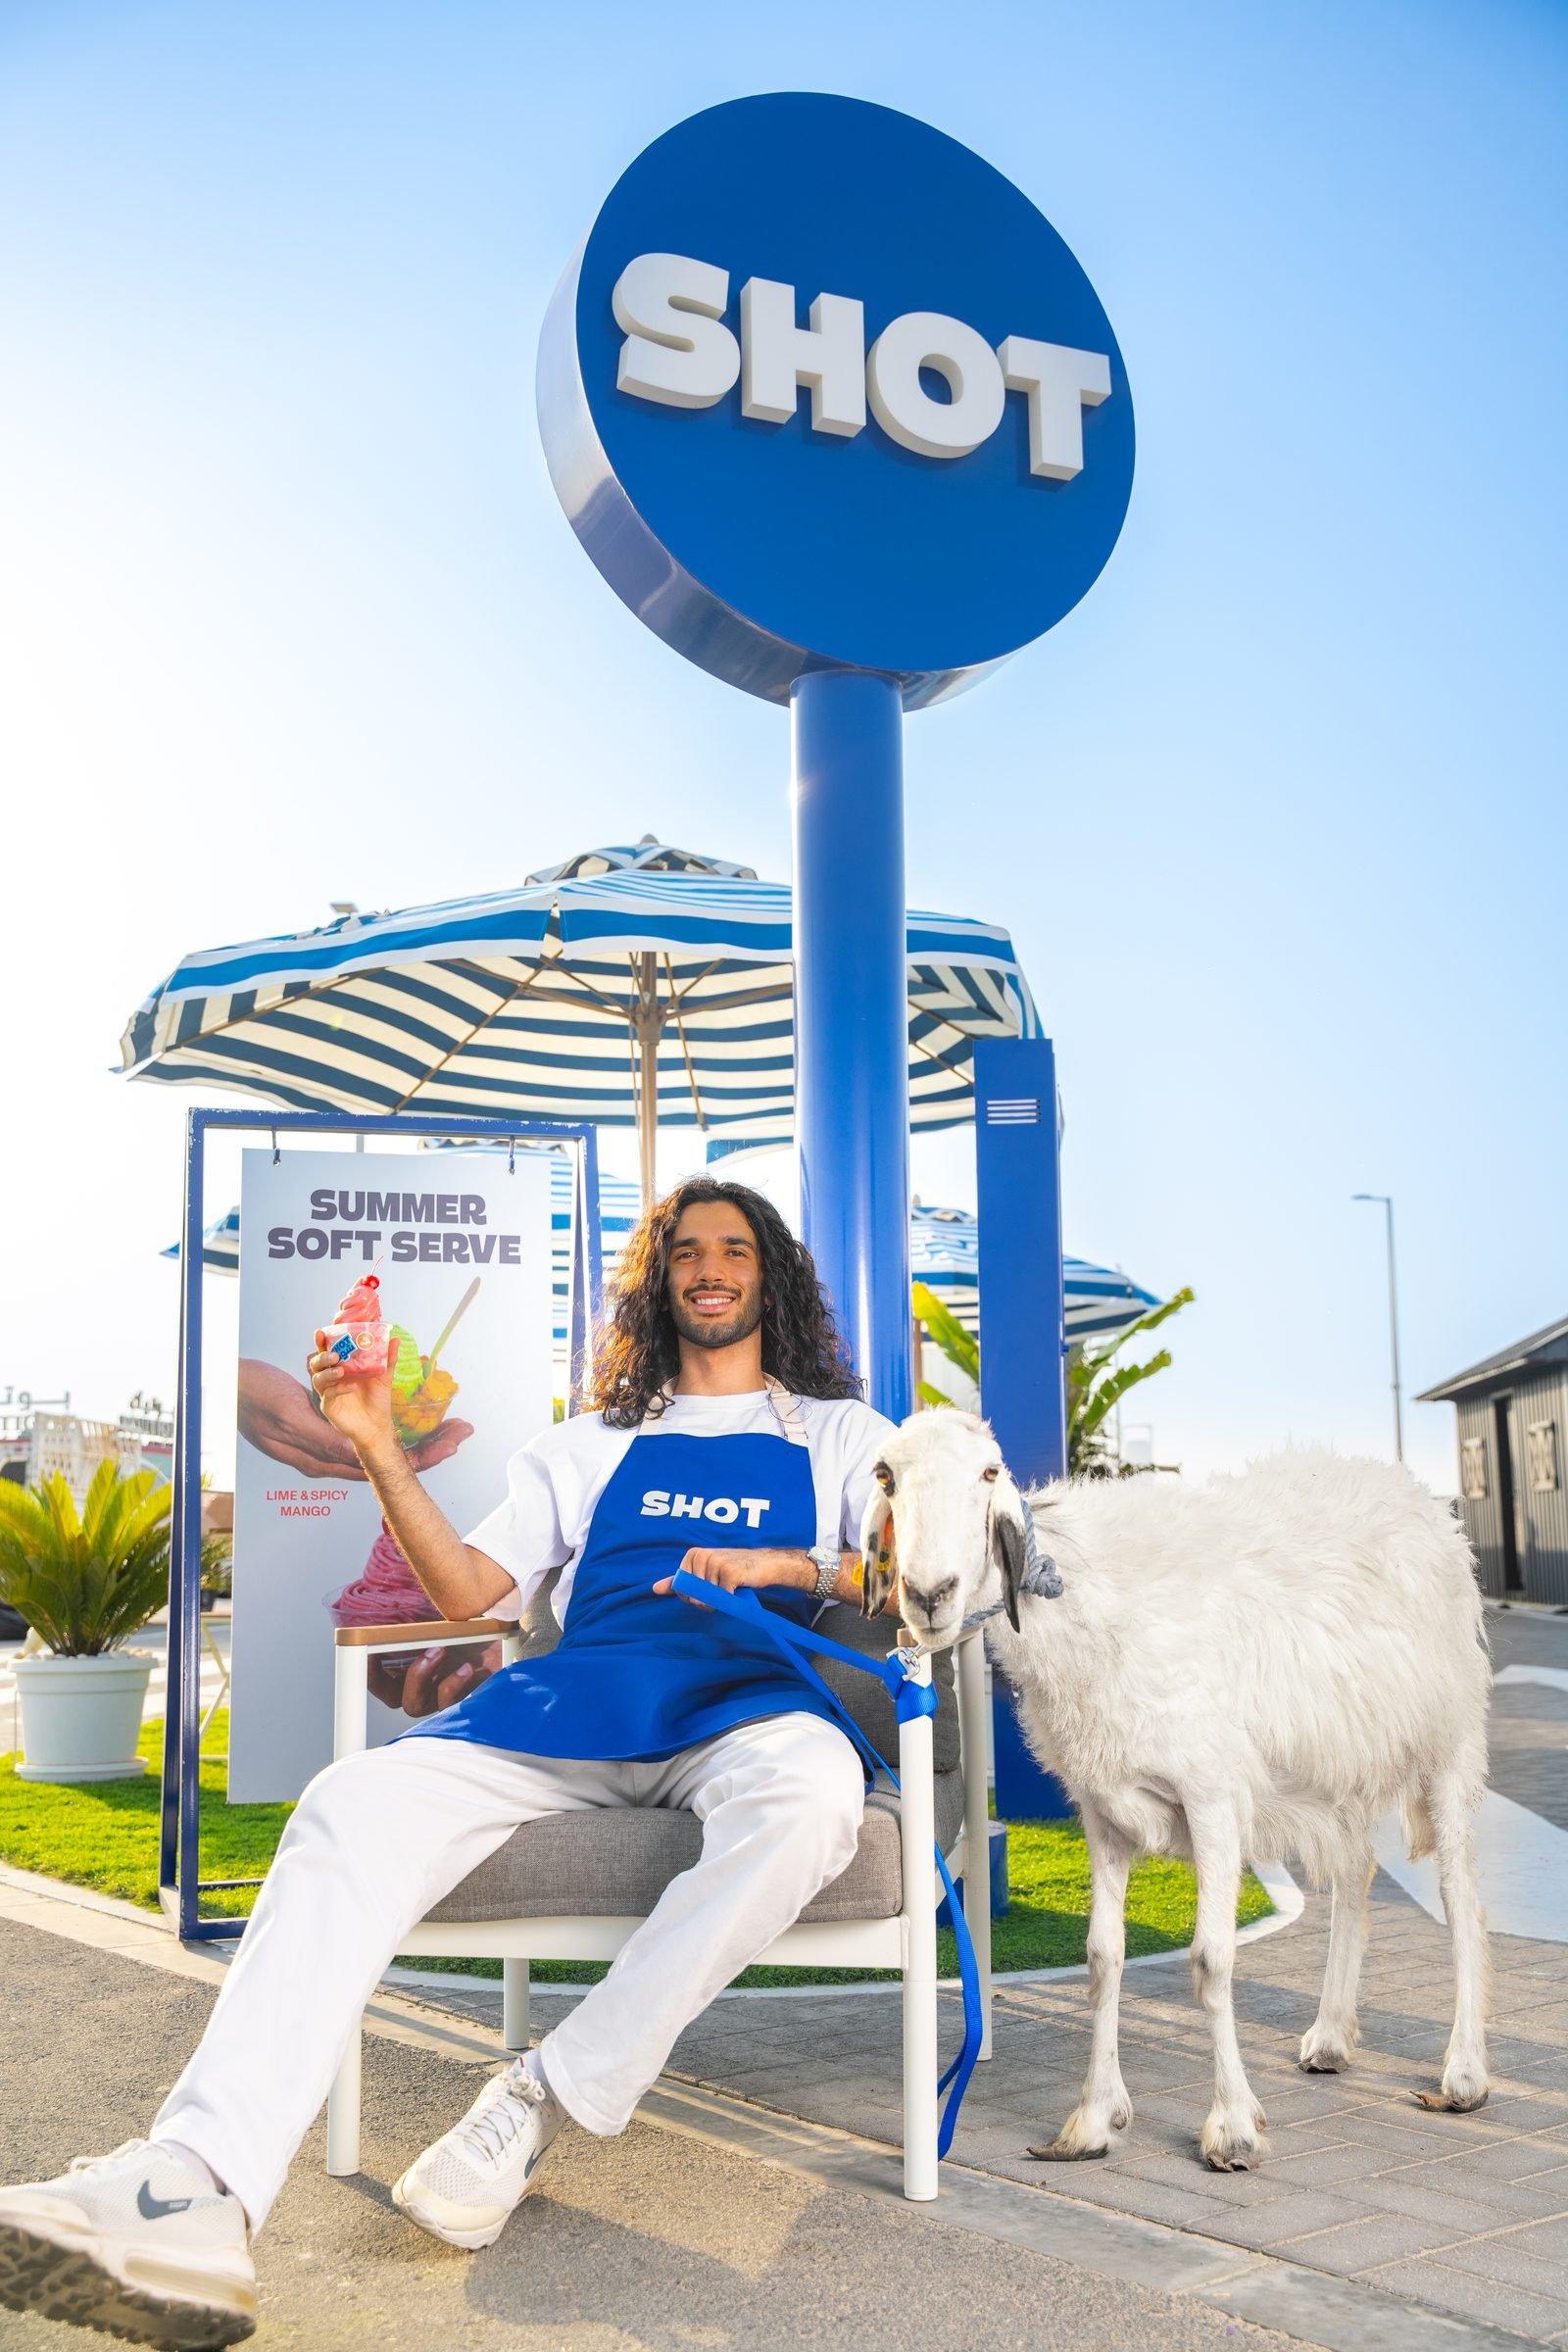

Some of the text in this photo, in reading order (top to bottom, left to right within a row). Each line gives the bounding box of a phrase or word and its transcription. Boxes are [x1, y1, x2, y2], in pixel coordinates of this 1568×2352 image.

[612, 252, 1112, 482] SHOT
[310, 1189, 487, 1225] SUMMER
[268, 1227, 521, 1264] SOFT SERVE
[266, 1490, 349, 1501] LIME & SPICY
[280, 1505, 331, 1517] MANGO
[640, 1490, 770, 1529] SHOT
